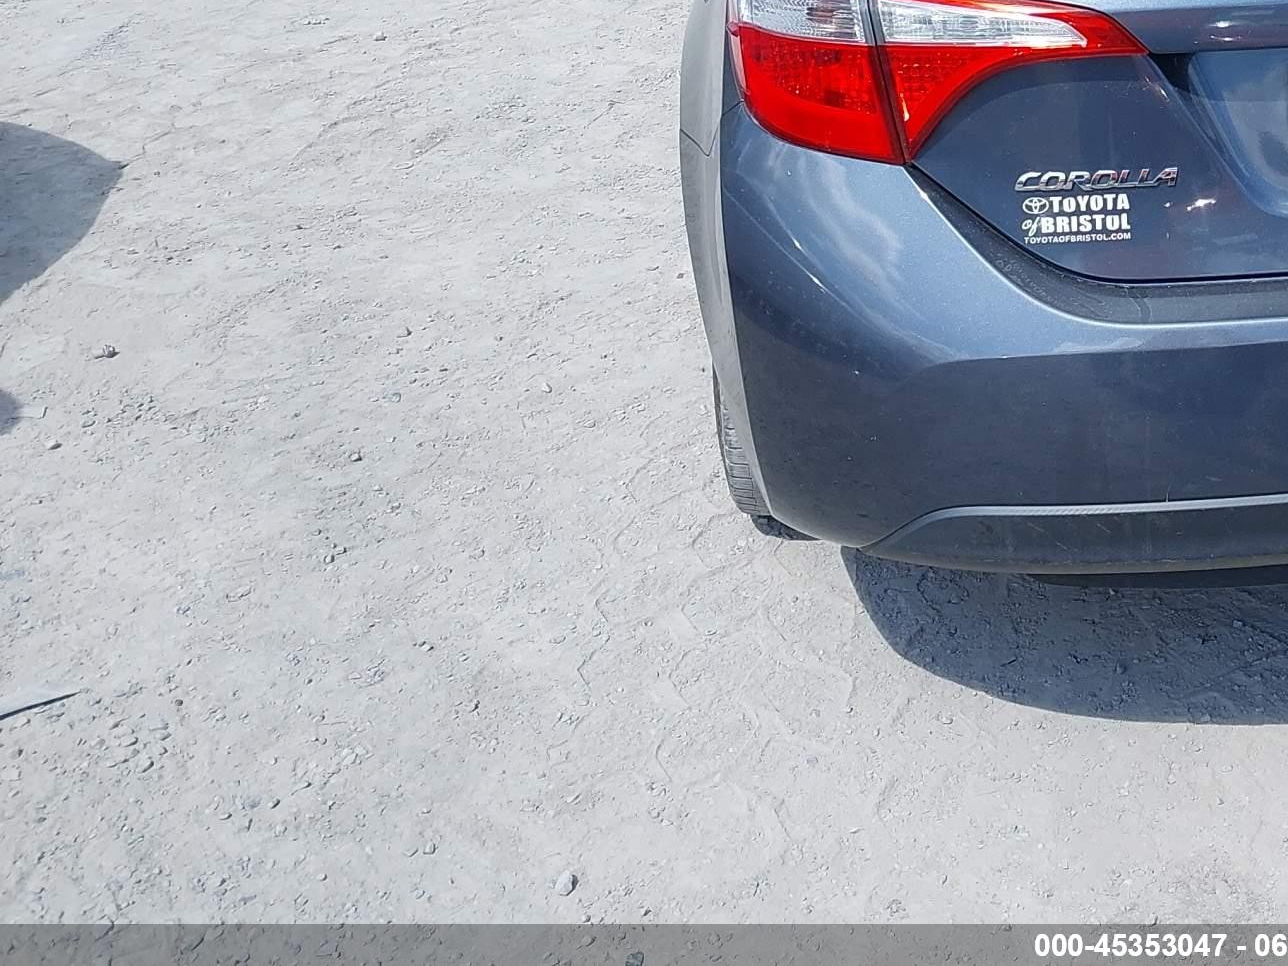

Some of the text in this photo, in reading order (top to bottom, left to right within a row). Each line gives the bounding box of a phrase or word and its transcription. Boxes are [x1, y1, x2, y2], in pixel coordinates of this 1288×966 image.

[1014, 166, 1178, 192] COROLLA
[1049, 194, 1130, 213] TOYOTA
[1022, 213, 1131, 236] of BRISTOL
[1024, 232, 1132, 245] TOYOTAOFBRISTOL.COM
